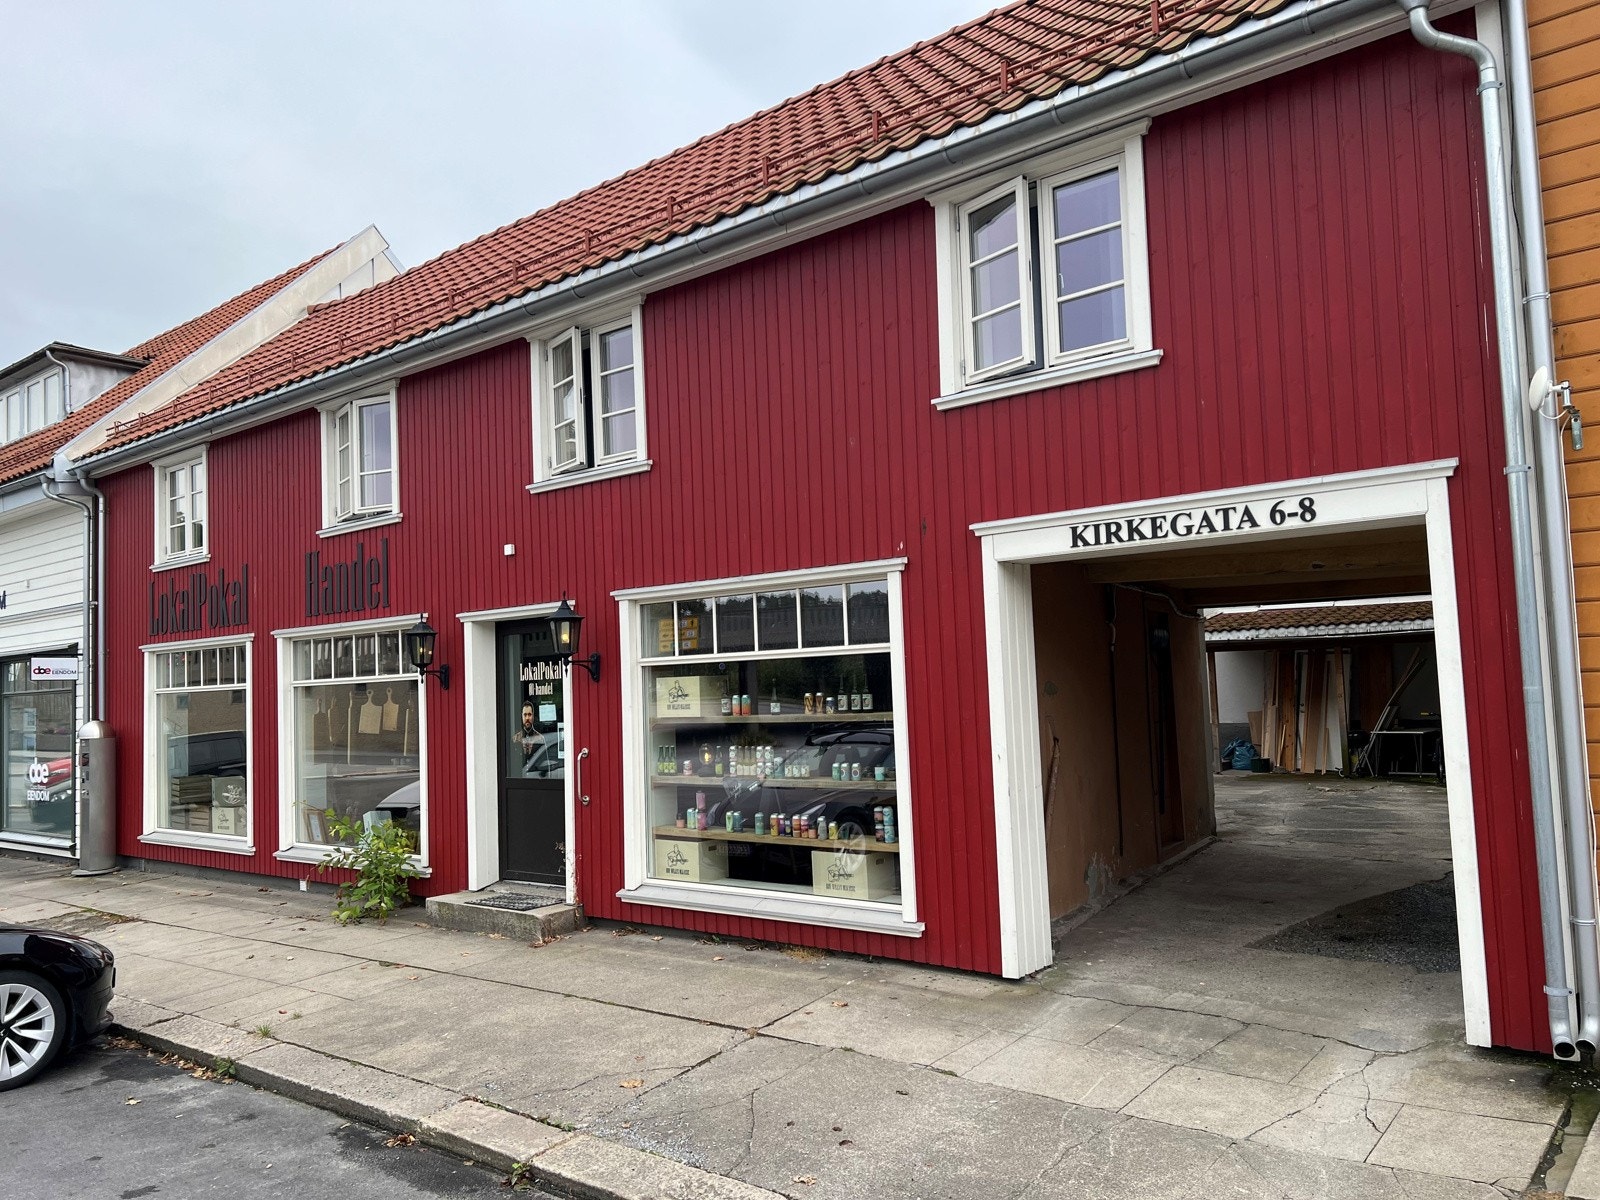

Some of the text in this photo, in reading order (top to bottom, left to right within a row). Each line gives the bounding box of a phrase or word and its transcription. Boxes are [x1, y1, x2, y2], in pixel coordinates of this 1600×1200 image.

[1070, 496, 1317, 549] KIRKEGATA 6-8
[149, 537, 390, 636] LokalPokal Handel
[519, 661, 562, 681] LokalPokal
